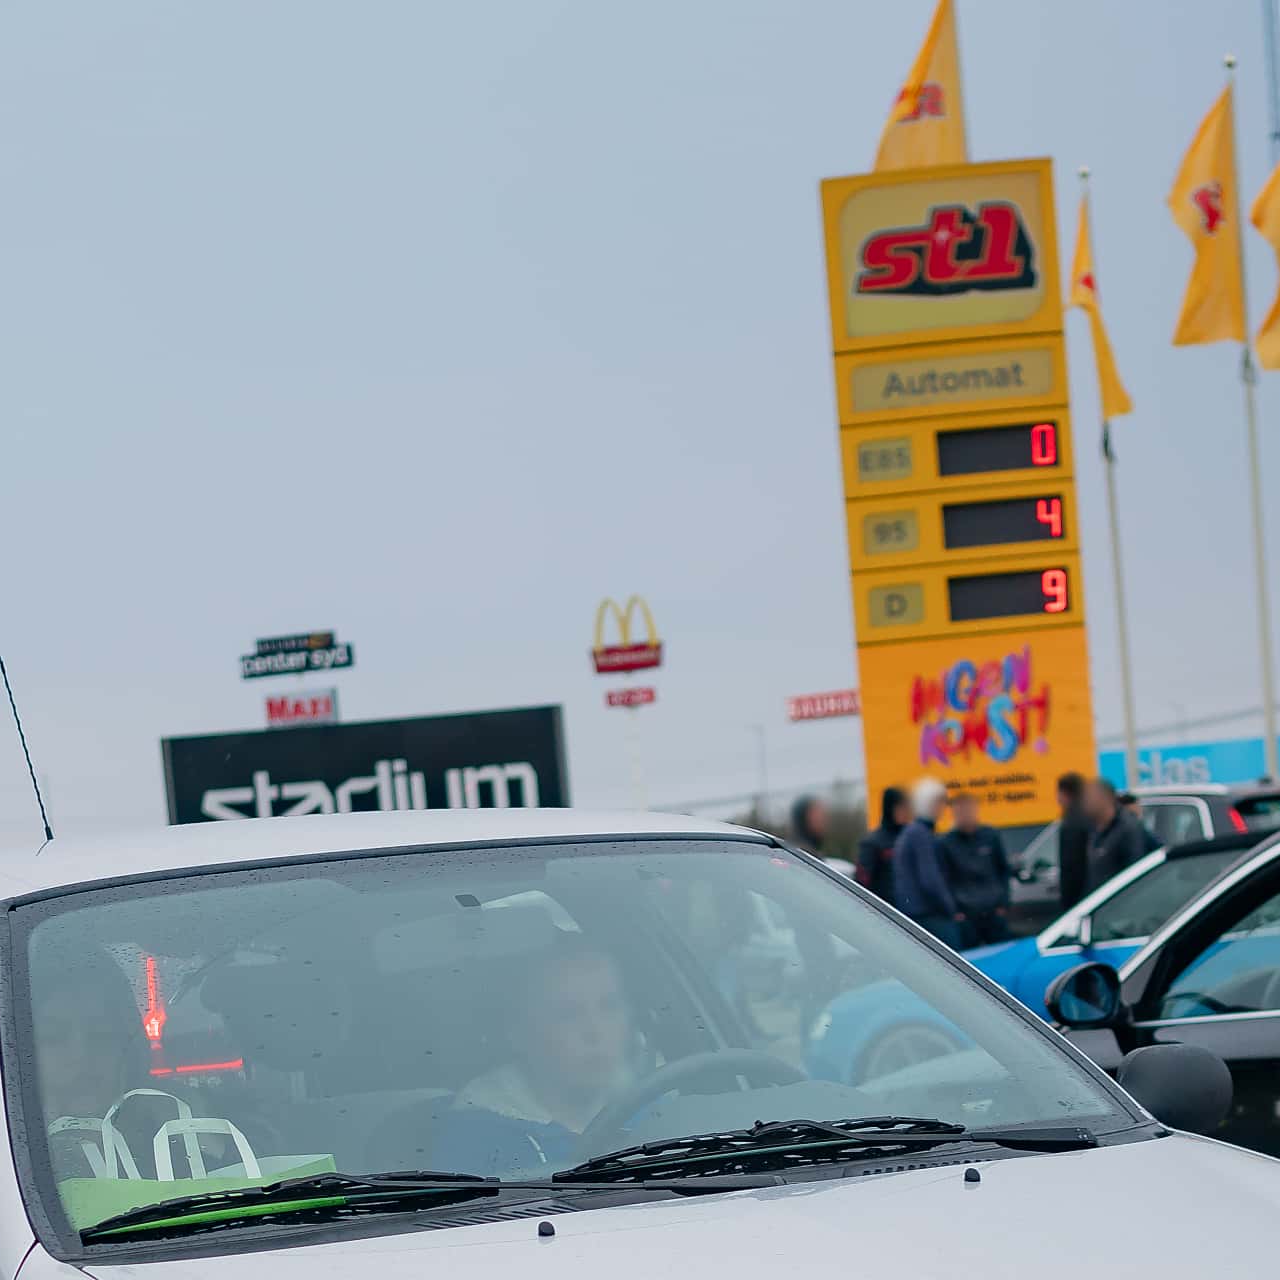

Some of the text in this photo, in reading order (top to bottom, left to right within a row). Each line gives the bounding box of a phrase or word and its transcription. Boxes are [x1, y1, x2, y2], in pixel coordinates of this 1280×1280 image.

[858, 202, 1036, 296] st1
[882, 362, 1024, 398] Automat
[1036, 498, 1063, 538] 4
[884, 593, 907, 618] D
[1041, 569, 1068, 614] 9
